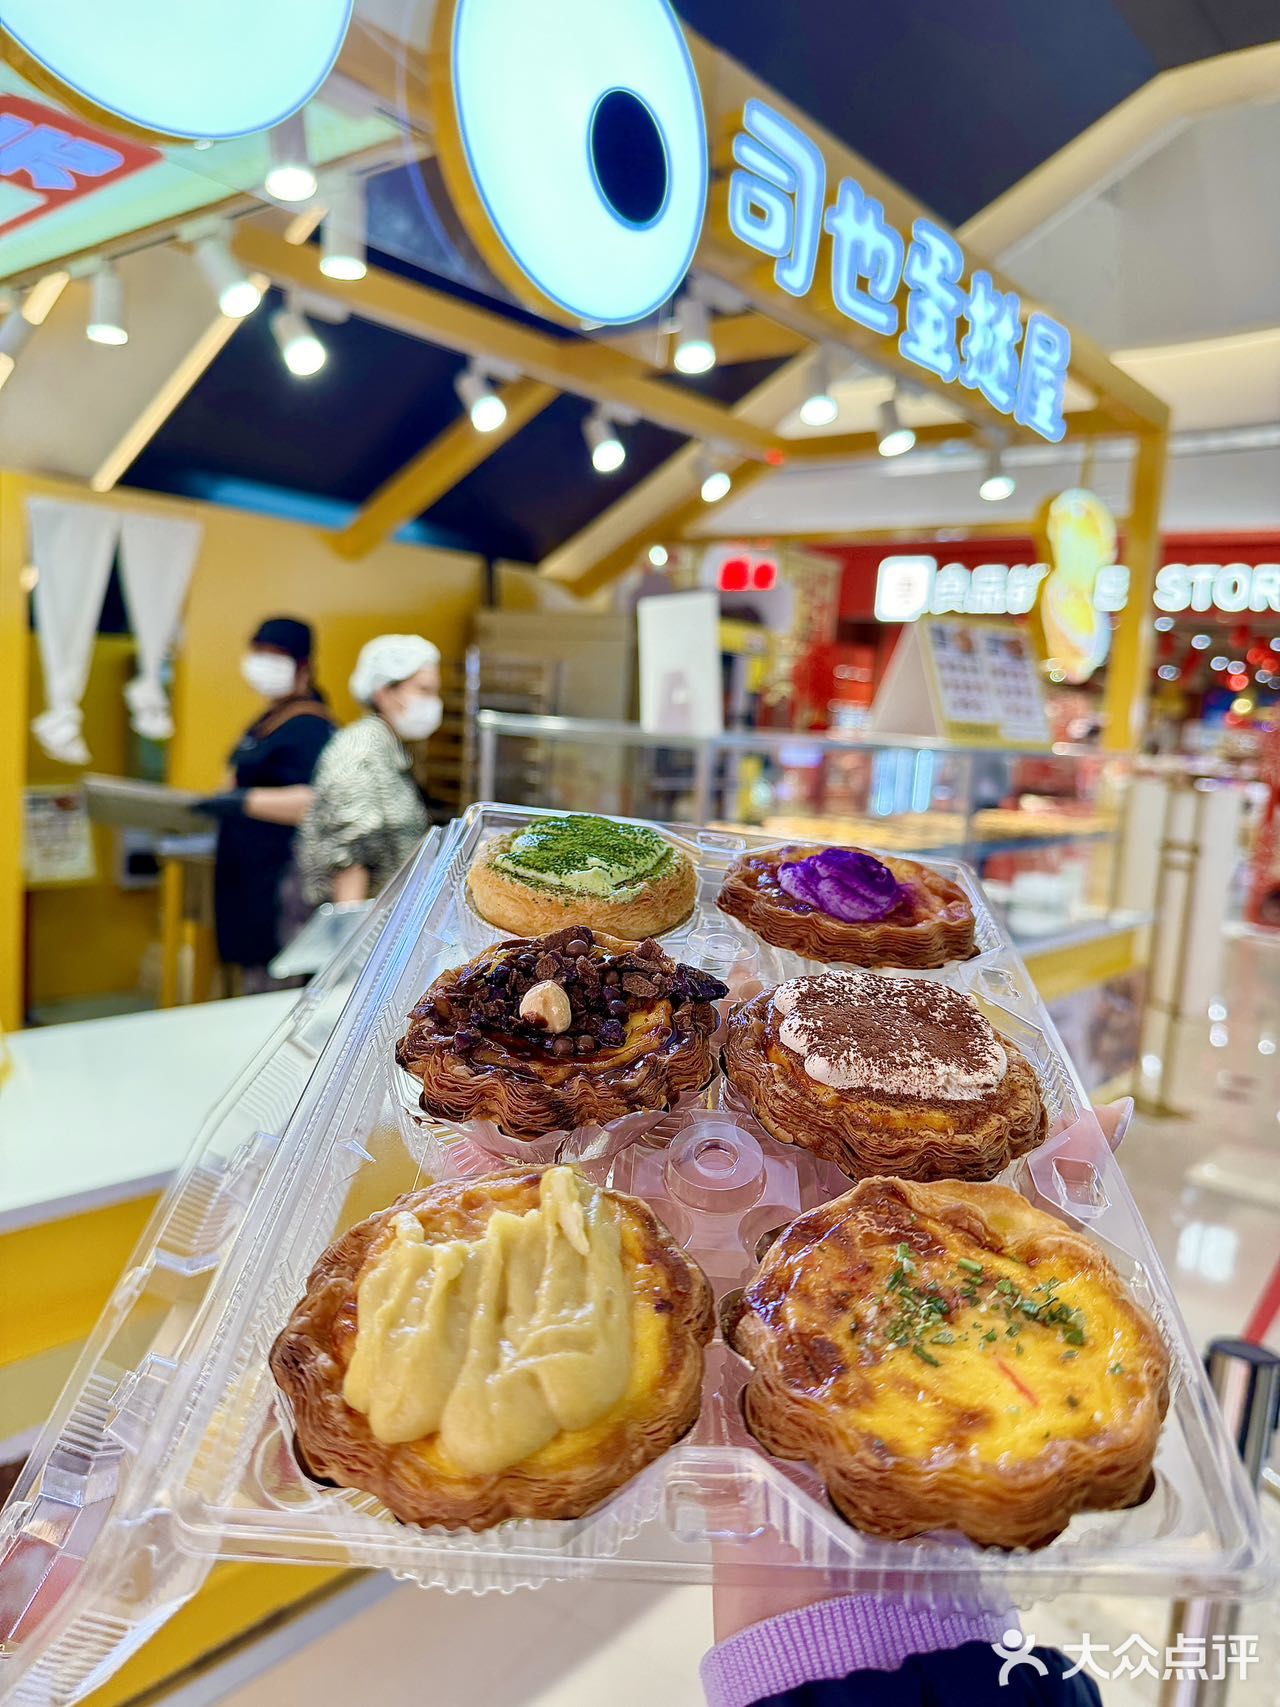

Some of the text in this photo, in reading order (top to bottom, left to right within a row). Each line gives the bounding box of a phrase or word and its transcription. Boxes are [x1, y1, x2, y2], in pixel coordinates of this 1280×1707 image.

[728, 98, 1071, 443] 司也蛋挞屋
[1153, 563, 1280, 613] STOR
